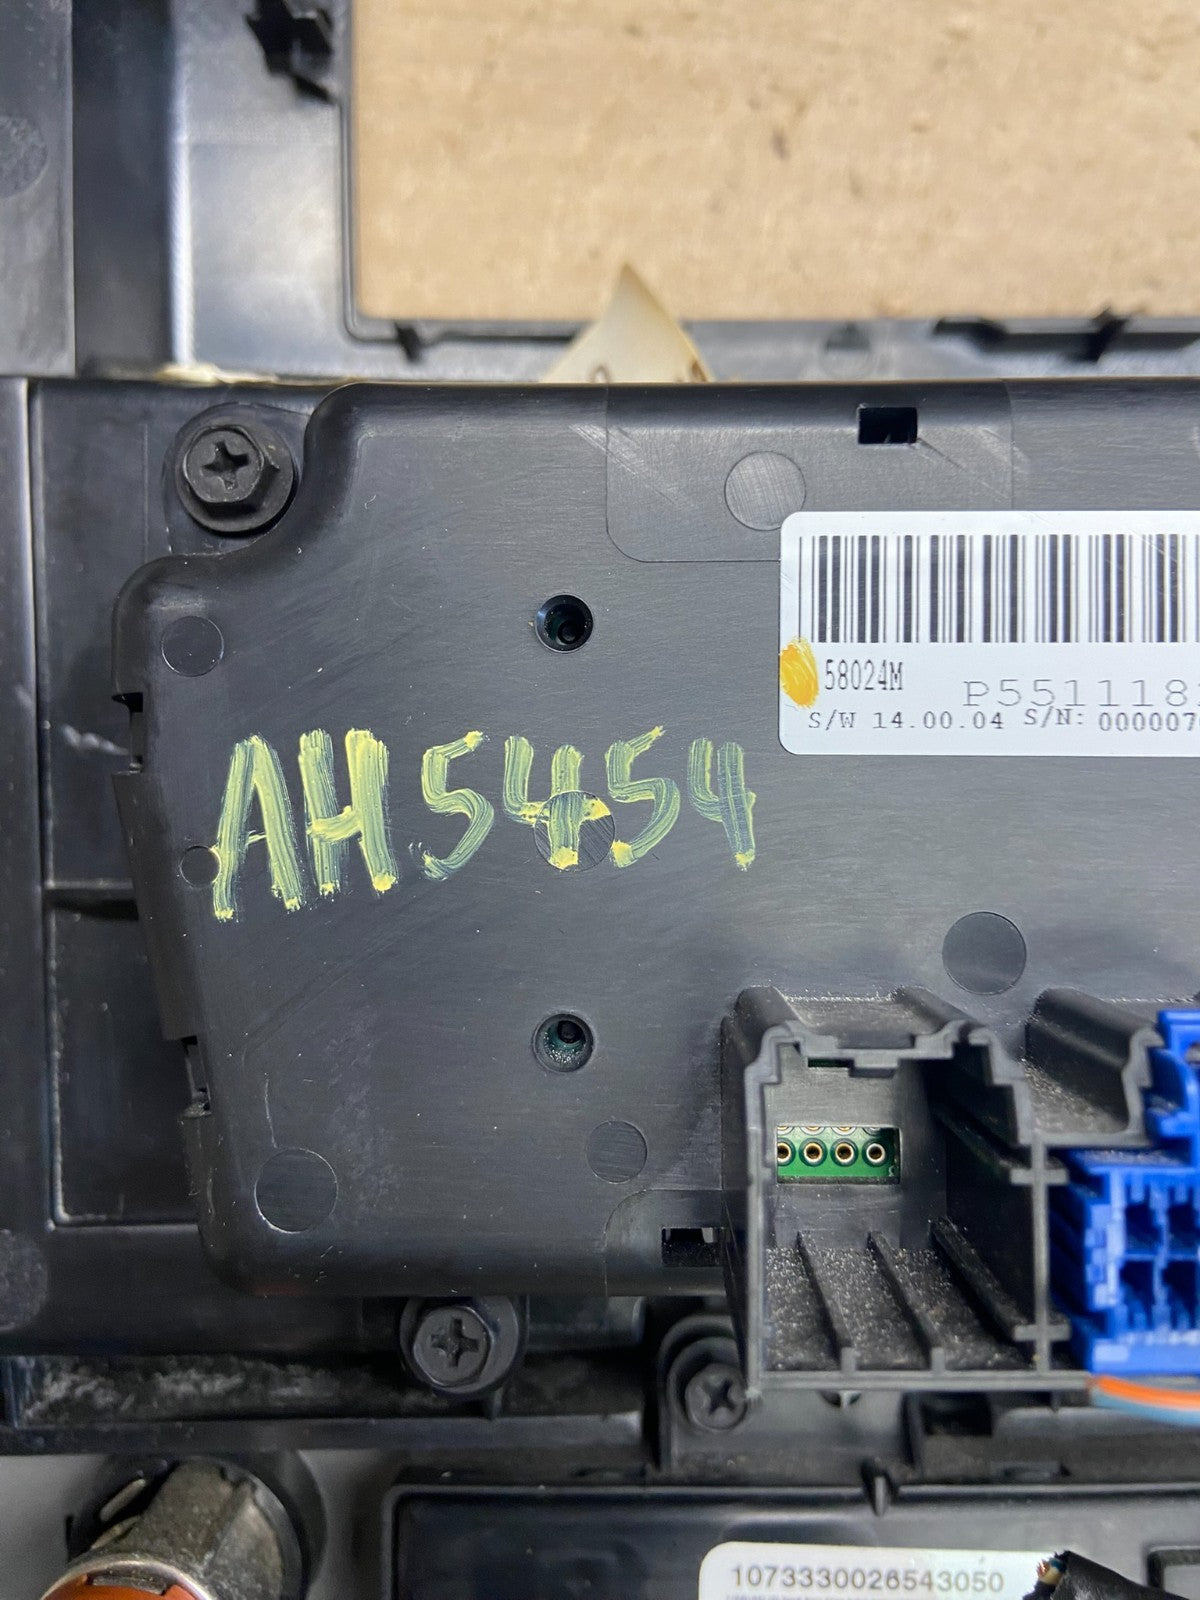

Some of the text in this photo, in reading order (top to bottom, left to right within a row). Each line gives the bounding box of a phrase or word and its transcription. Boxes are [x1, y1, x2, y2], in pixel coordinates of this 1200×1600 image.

[824, 658, 904, 691] 58024M
[963, 679, 1200, 707] P551118
[808, 706, 1200, 732] S/W 14.00.04 S/N: 000007
[732, 1565, 1004, 1592] 1073330026543050
